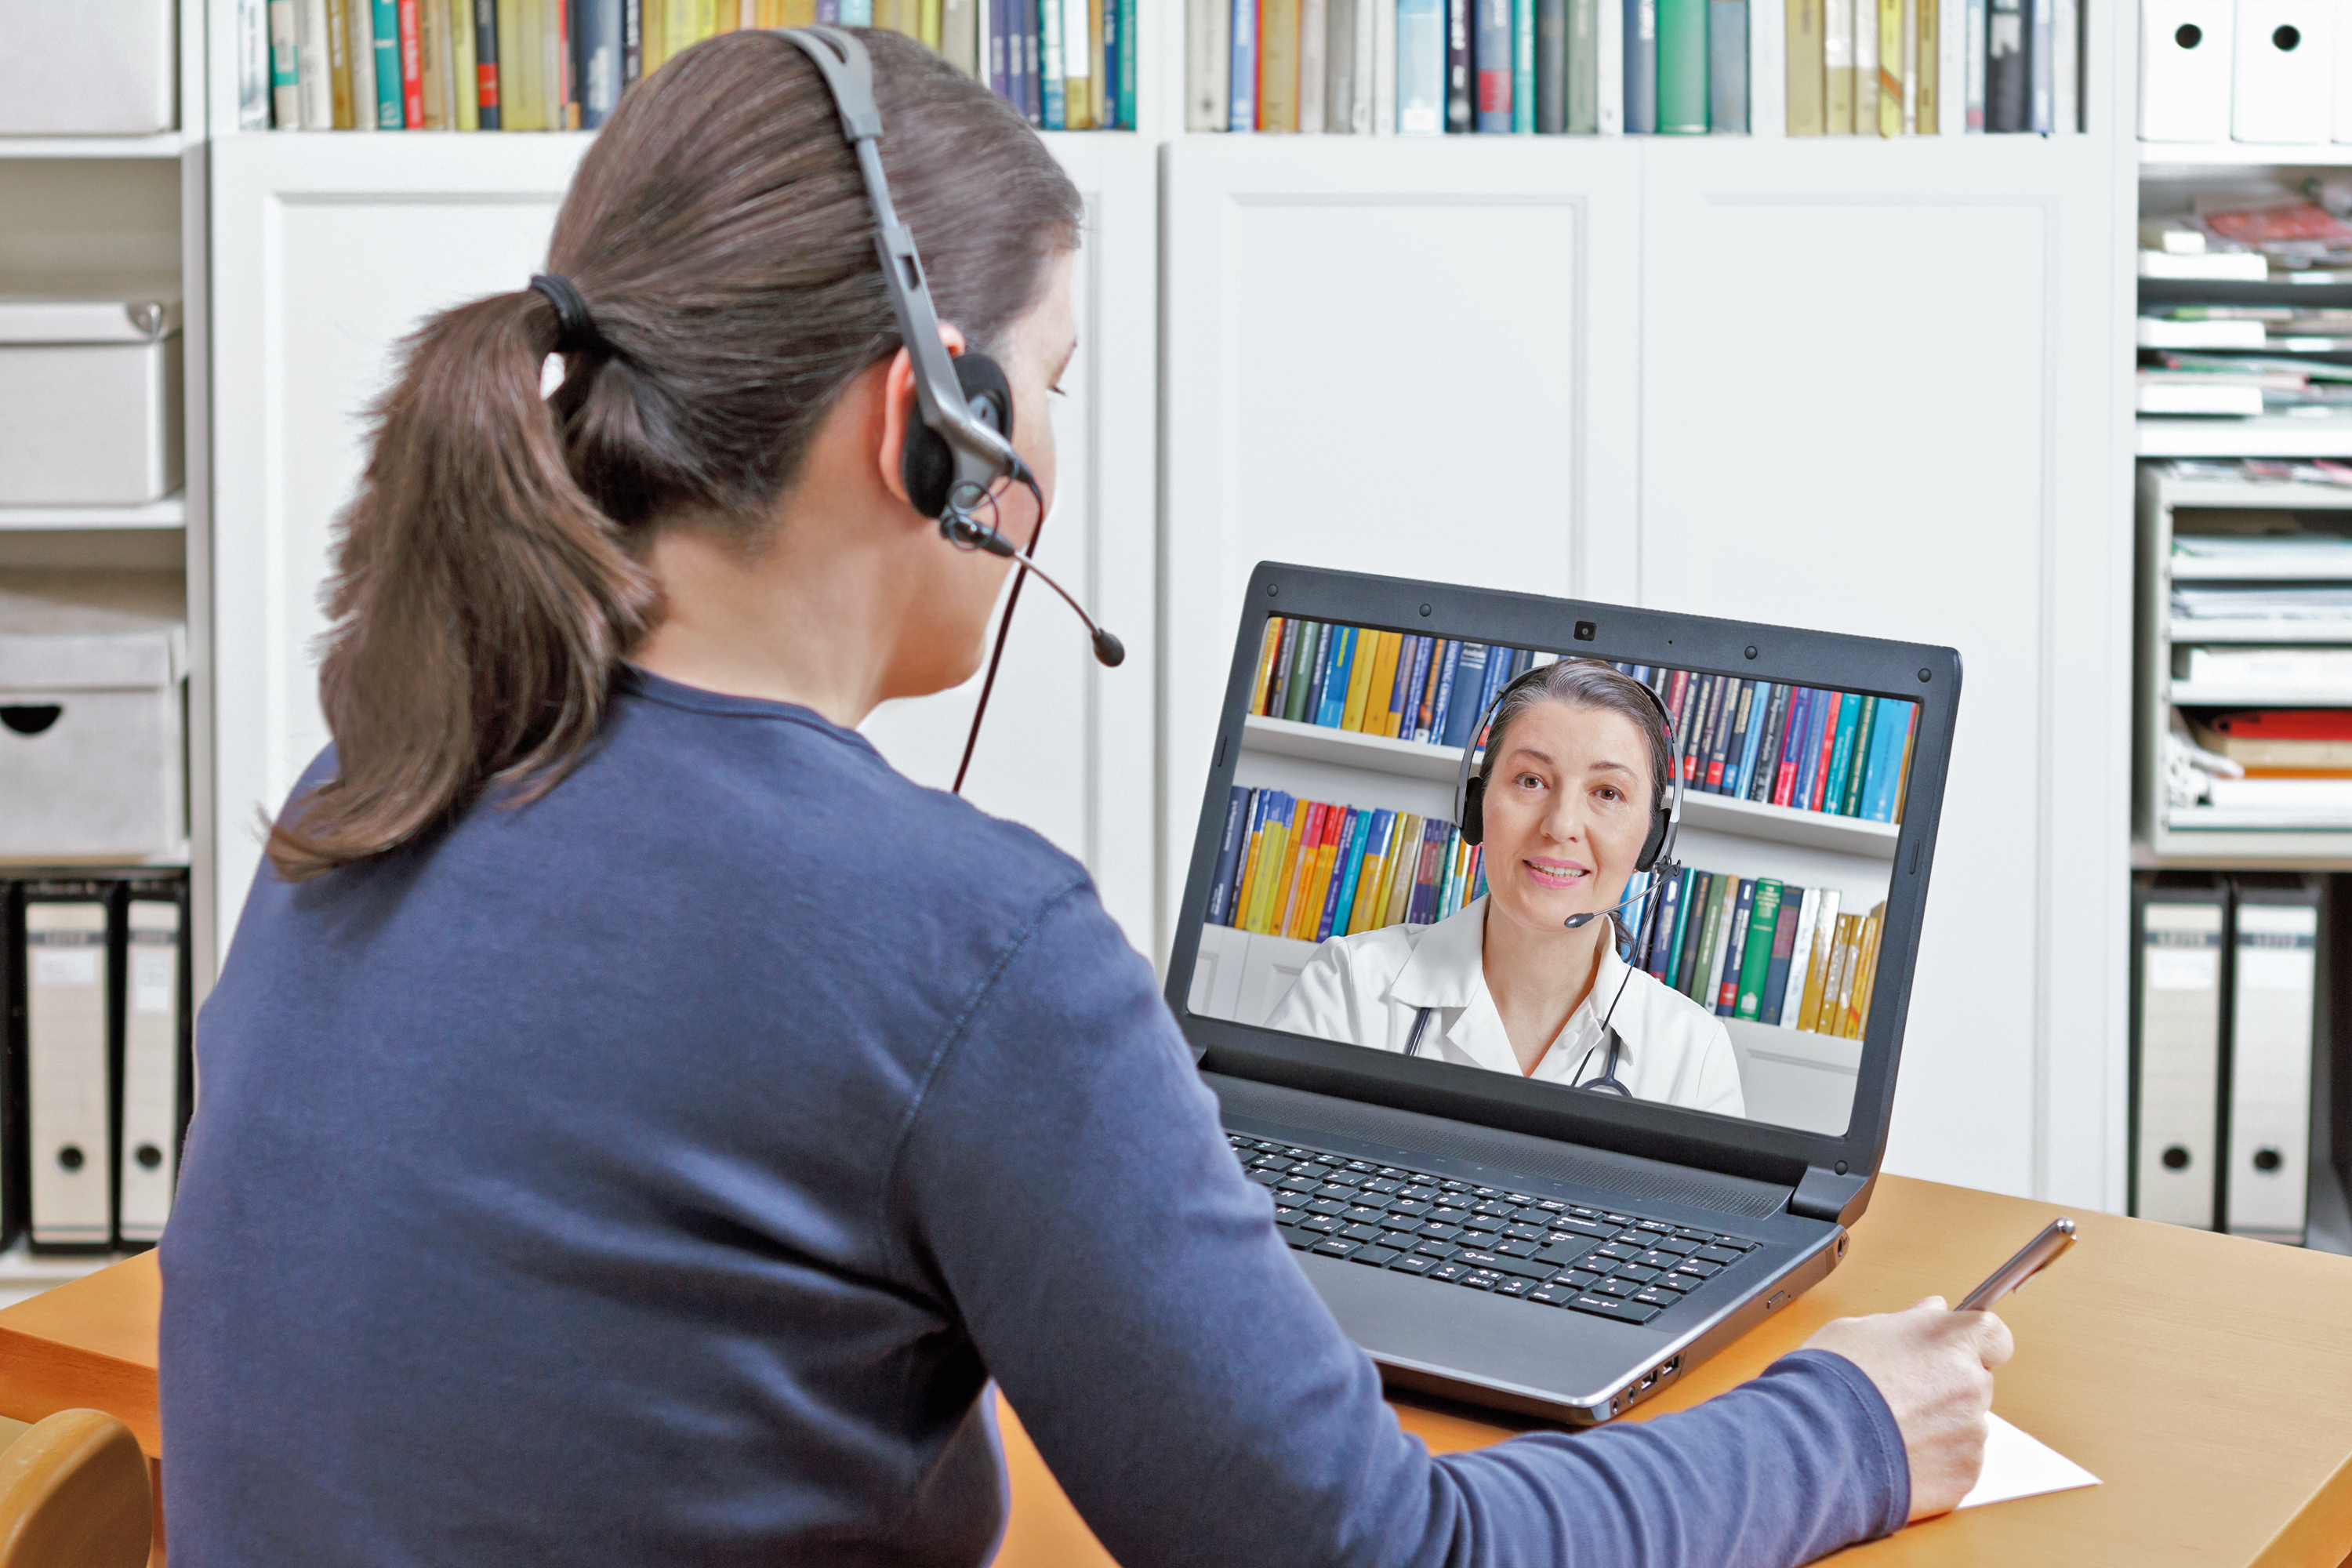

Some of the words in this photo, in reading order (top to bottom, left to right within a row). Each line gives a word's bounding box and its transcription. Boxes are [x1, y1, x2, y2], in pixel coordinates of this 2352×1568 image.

[1766, 698, 1780, 734] Regression
[1761, 733, 1773, 761] Analysis
[1561, 1217, 1596, 1227] Backspace
